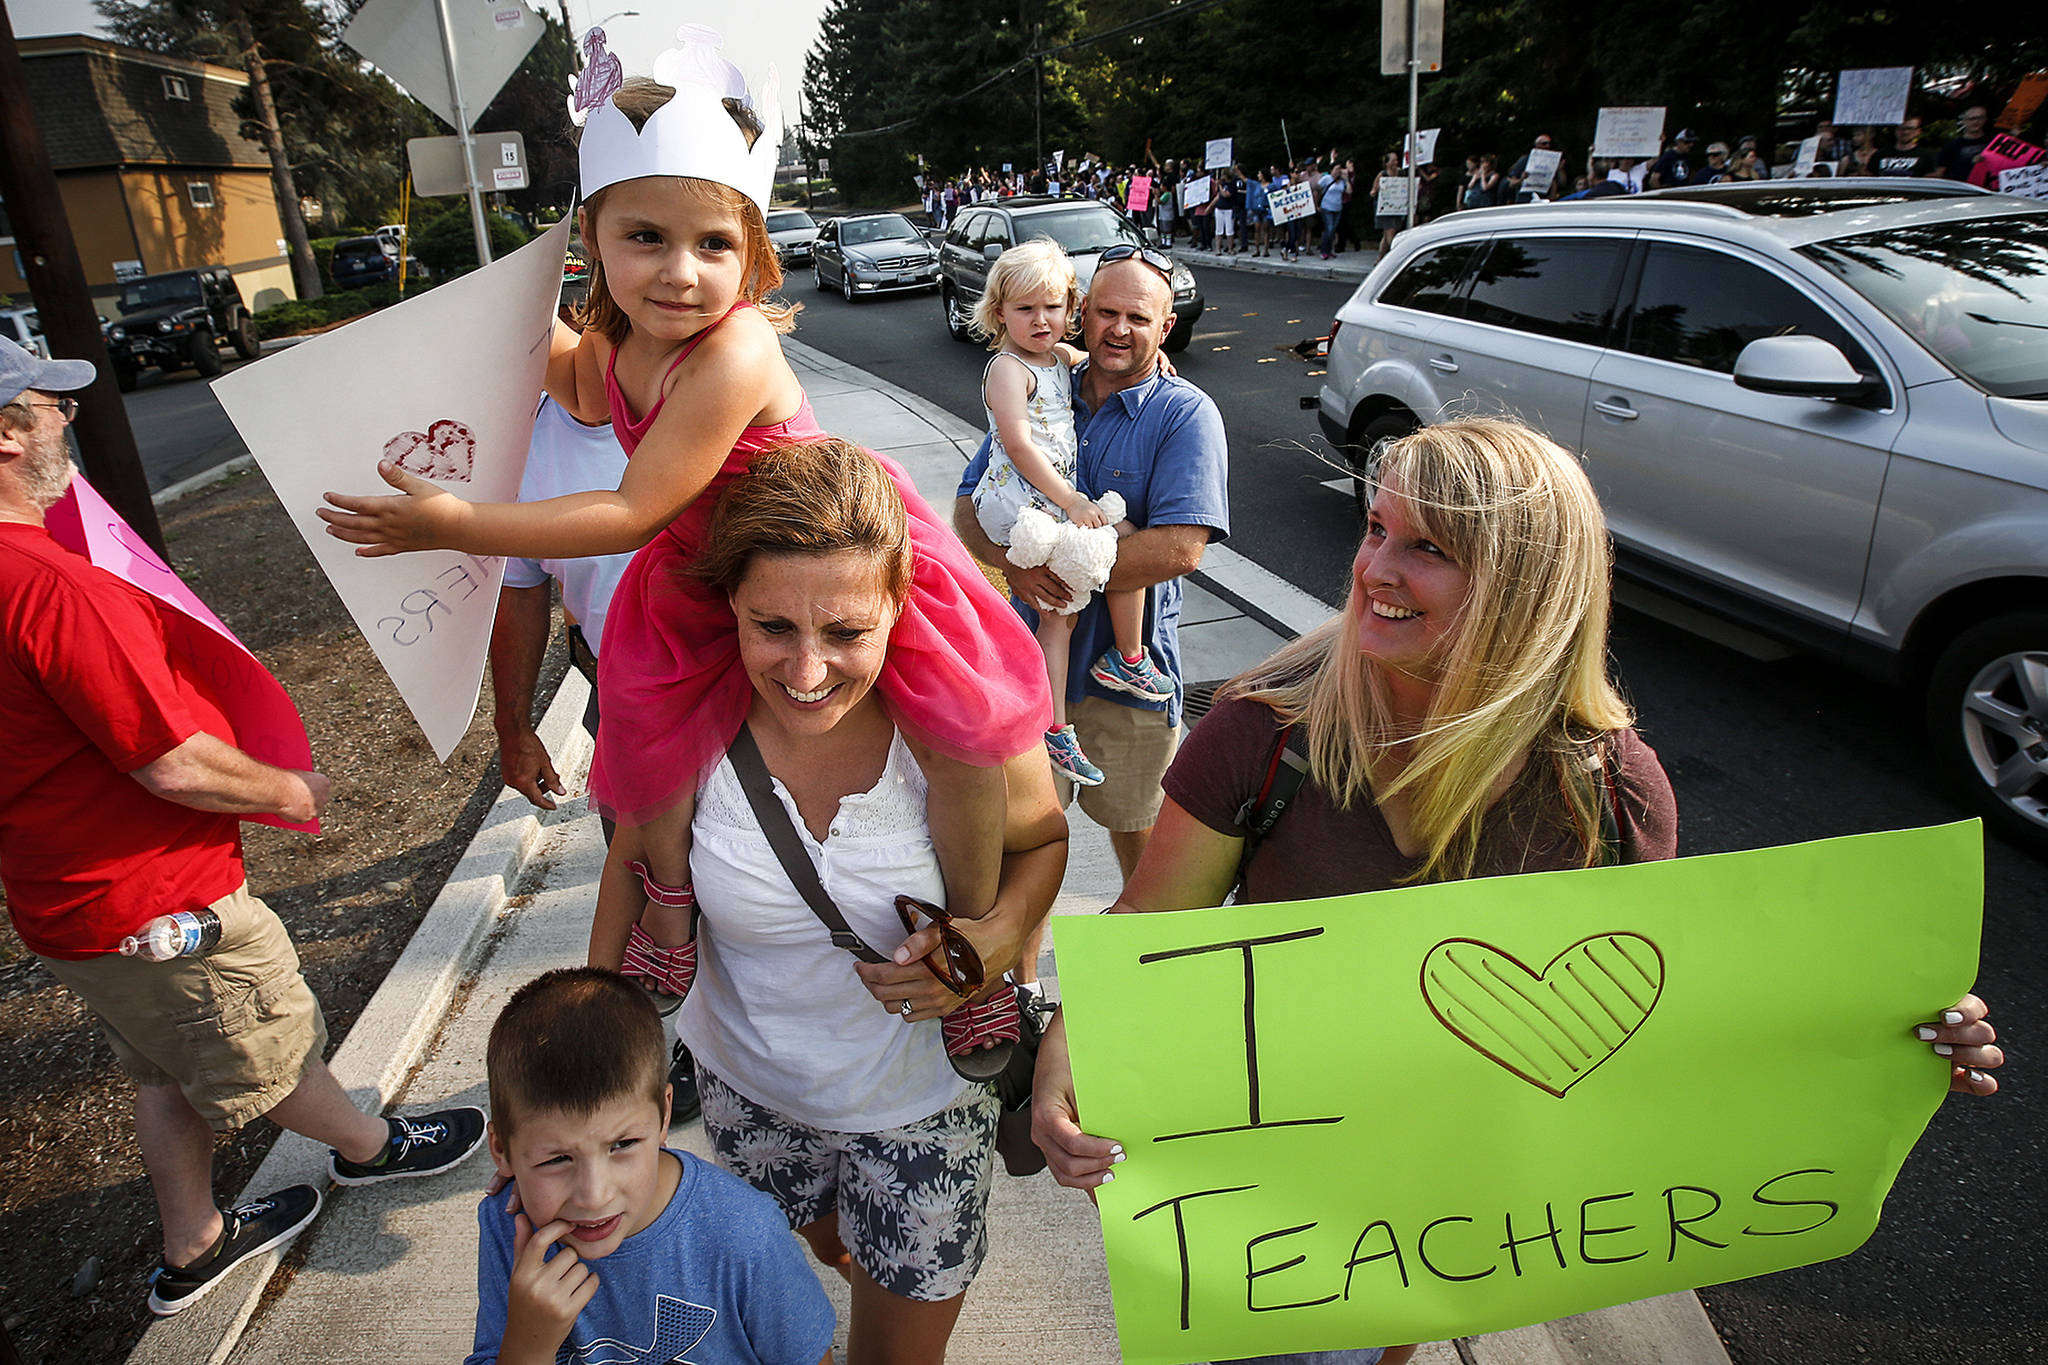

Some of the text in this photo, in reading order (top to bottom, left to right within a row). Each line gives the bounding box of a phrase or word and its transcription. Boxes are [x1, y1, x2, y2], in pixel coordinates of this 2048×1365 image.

[505, 151, 516, 161] 15
[1274, 190, 1310, 208] DESERVE
[1139, 927, 1344, 1143] I
[1132, 1167, 1840, 1331] TEACHERS
